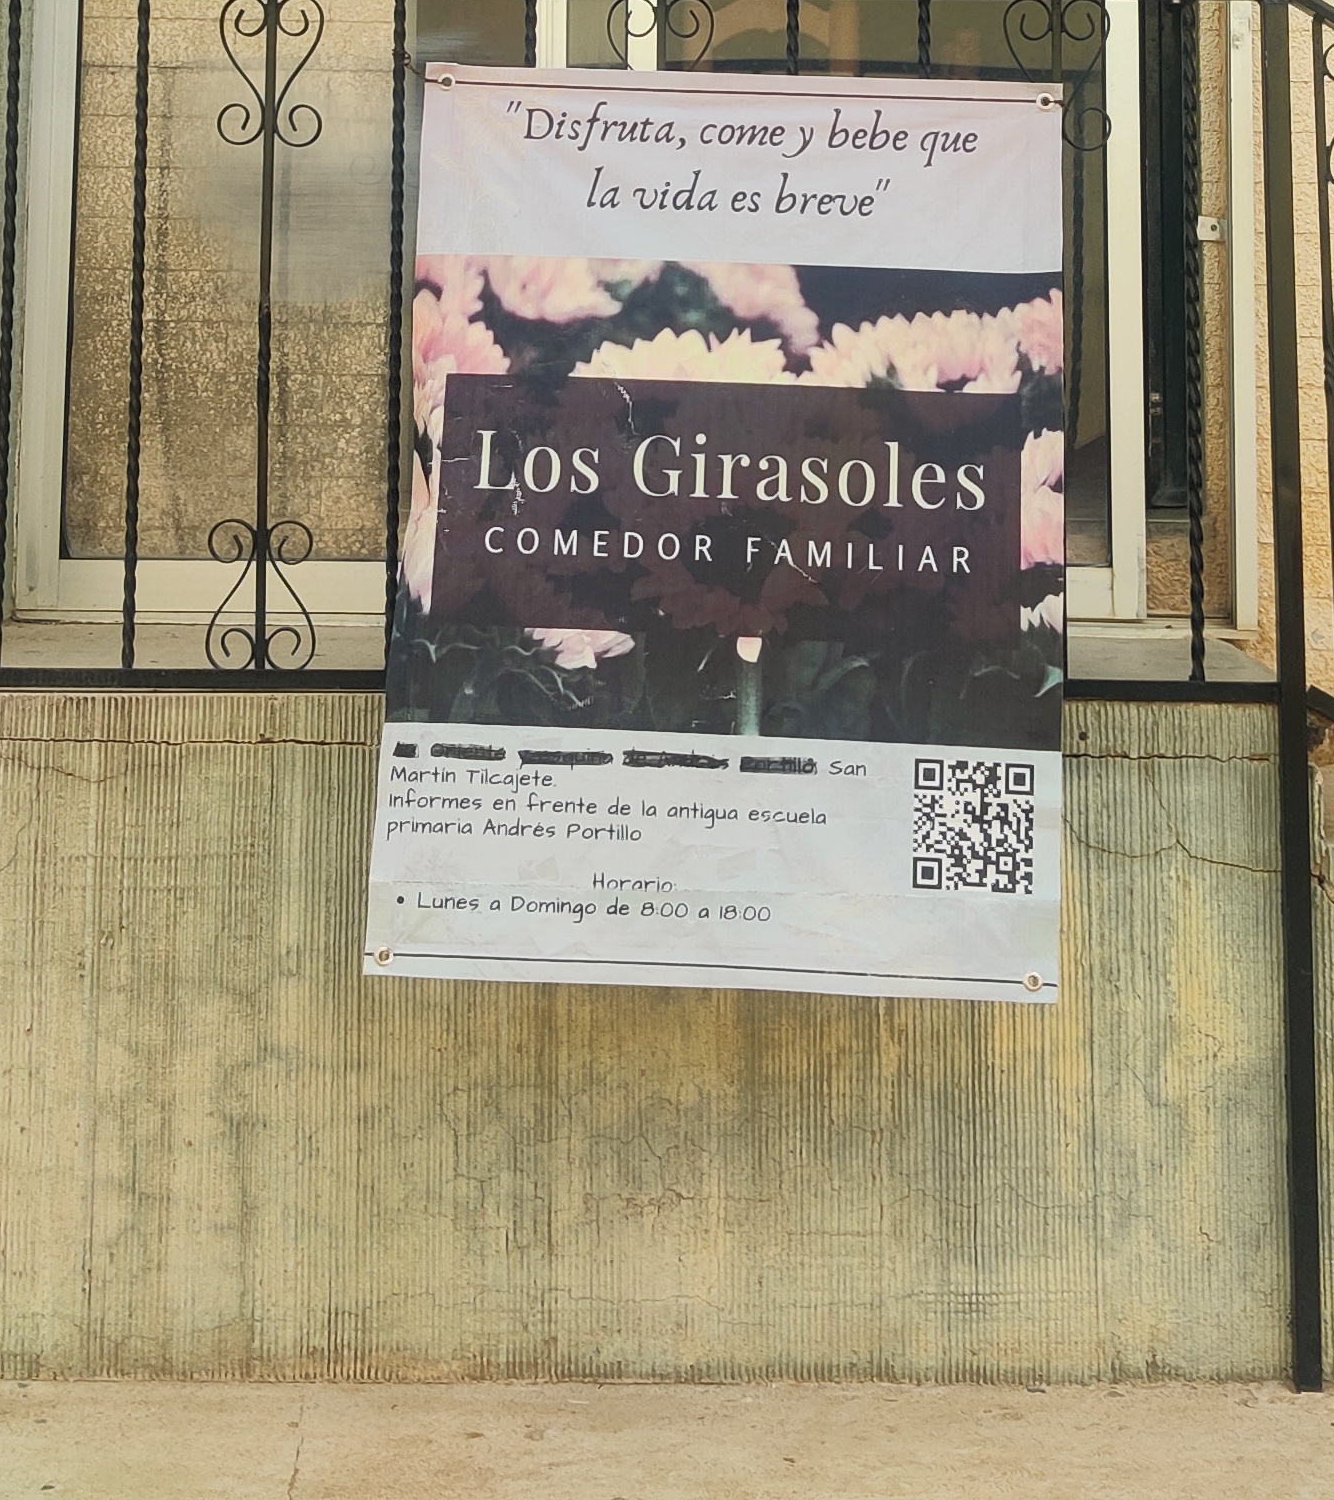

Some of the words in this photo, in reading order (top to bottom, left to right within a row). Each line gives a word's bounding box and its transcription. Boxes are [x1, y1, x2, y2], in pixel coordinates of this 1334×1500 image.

[507, 101, 686, 151] "Disfruta,
[700, 124, 785, 149] come
[782, 128, 815, 158] y
[828, 108, 908, 151] bebe
[920, 131, 978, 168] que
[587, 166, 620, 209] la
[633, 170, 718, 212] vida
[731, 190, 761, 213] es
[775, 172, 891, 217] breve"
[474, 430, 600, 495] Los
[633, 433, 986, 510] Girasoles
[485, 526, 713, 562] COMEDOR
[746, 537, 971, 573] FAMILIAR
[466, 768, 556, 794] Tilcajete.
[828, 760, 867, 776] San
[389, 788, 482, 810] Informes
[492, 798, 516, 811] en
[526, 792, 597, 815] frente
[607, 797, 631, 815] de
[641, 799, 657, 817] la
[666, 802, 738, 829] antigua
[748, 808, 827, 825] escuela
[386, 817, 473, 841] primaria
[482, 818, 556, 838] Andrés
[566, 823, 642, 842] Portillo
[592, 872, 677, 893] Horario:
[417, 892, 479, 911] Lunes
[489, 900, 501, 912] a
[510, 895, 597, 923] Domingo
[605, 896, 630, 916] de
[640, 902, 689, 918] 8:00
[697, 907, 710, 919] a
[719, 905, 771, 922] 18:00
